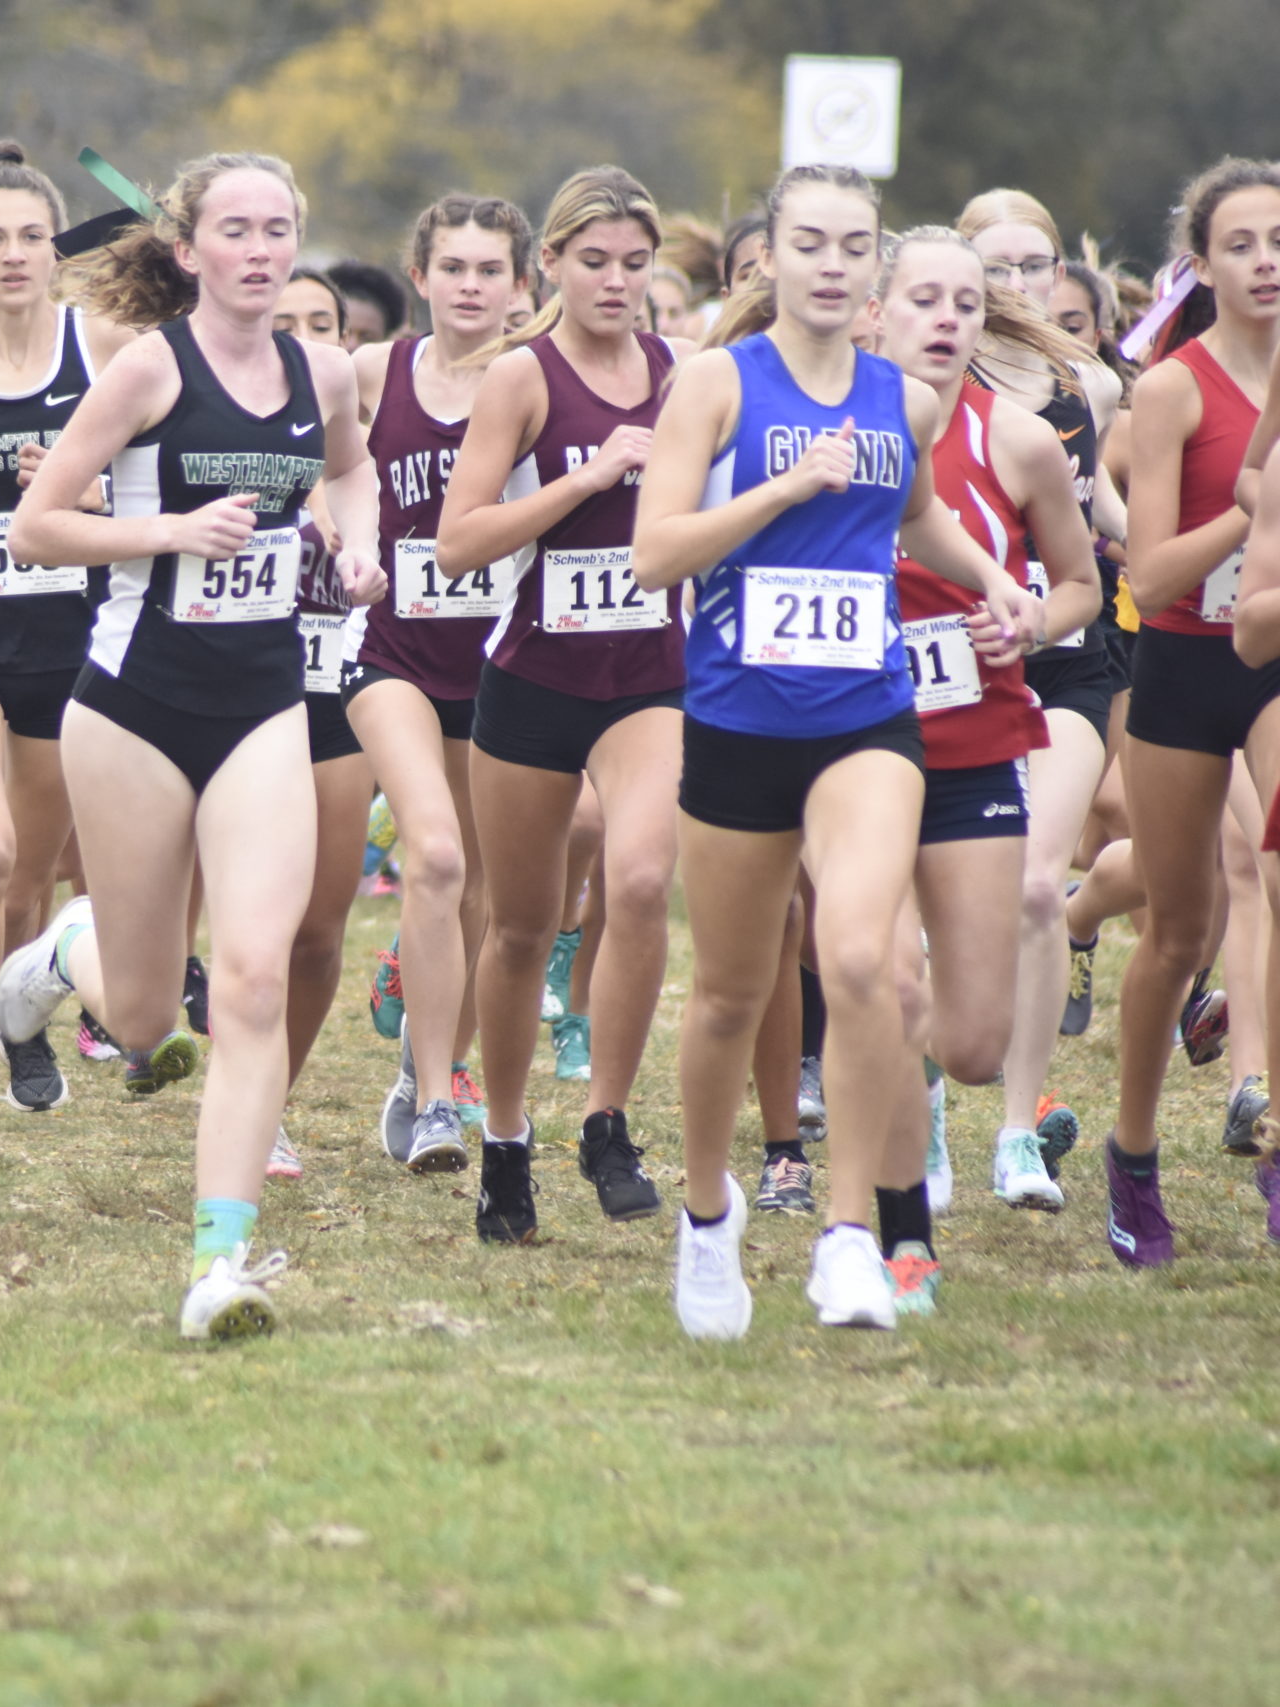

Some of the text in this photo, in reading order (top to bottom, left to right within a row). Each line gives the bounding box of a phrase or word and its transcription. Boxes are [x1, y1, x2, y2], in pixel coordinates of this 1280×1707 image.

[766, 426, 903, 489] GLNN
[390, 451, 431, 510] BAY
[247, 533, 294, 547] 2nd Wind
[553, 551, 629, 565] Schwab's 2nd
[203, 553, 277, 599] 554
[422, 560, 494, 597] 124
[571, 568, 644, 610] 112
[758, 573, 817, 586] Schwab's
[821, 575, 844, 588] 2nd
[318, 618, 342, 629] Wind
[773, 593, 858, 642] 218
[904, 620, 960, 638] 2nd Wind
